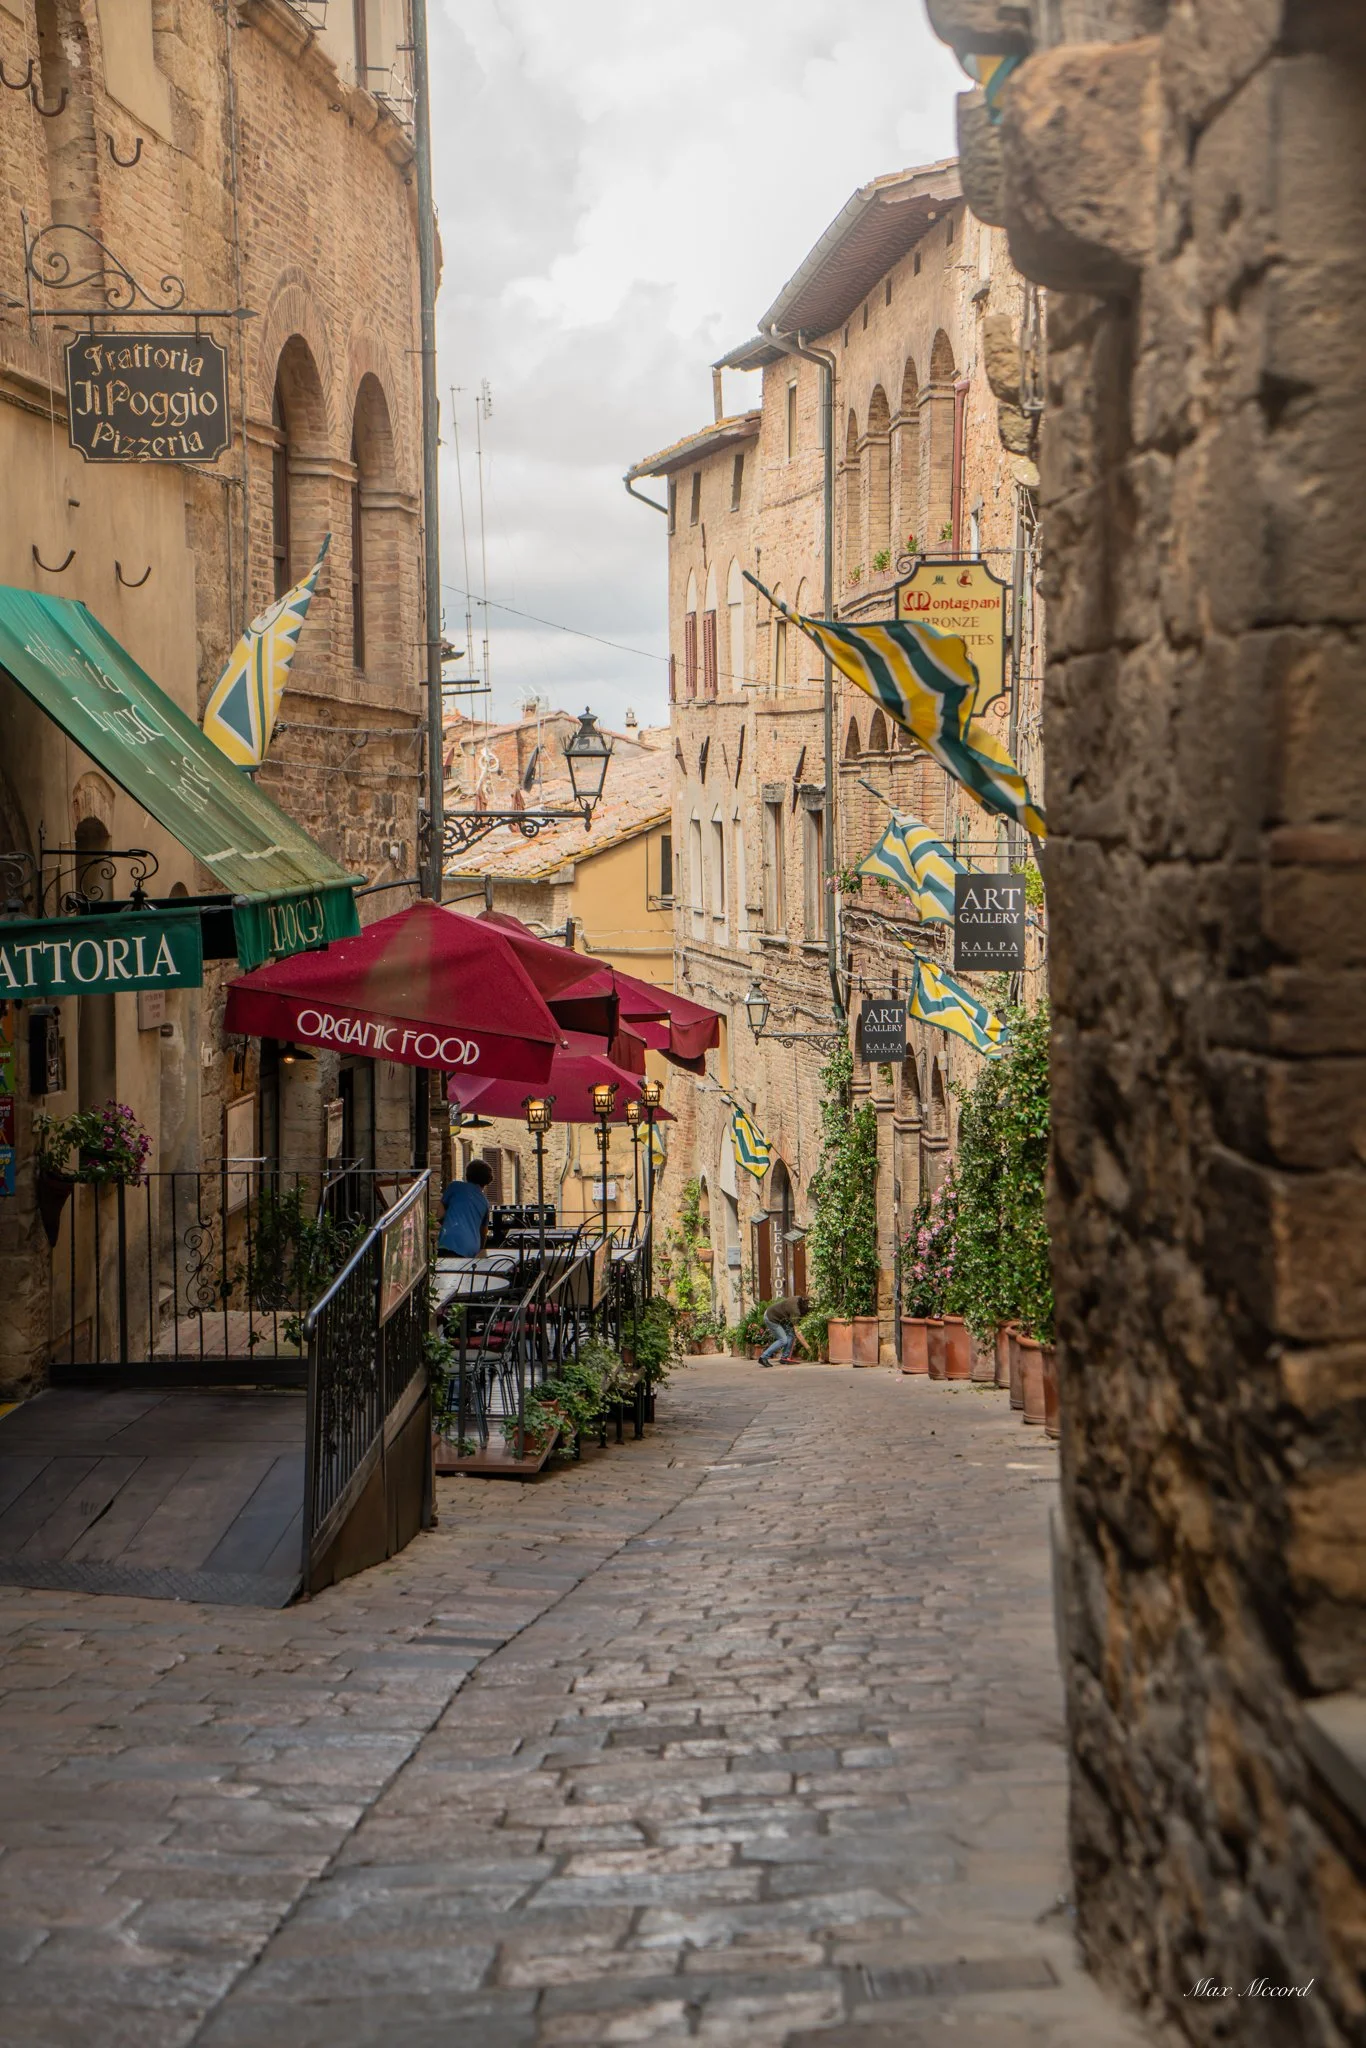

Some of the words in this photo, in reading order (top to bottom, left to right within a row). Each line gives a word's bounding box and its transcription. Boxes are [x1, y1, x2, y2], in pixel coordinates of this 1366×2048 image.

[85, 344, 204, 377] Trattoria
[107, 380, 218, 427] Poggio
[91, 422, 204, 462] Pizzeria
[903, 590, 1000, 612] Montagnani
[960, 888, 1021, 910] ART
[960, 912, 1020, 924] GALLERY
[961, 942, 1018, 951] KALPA
[865, 1009, 903, 1023] ART
[297, 1010, 398, 1053] ORGANIC
[401, 1030, 480, 1065] FOOD
